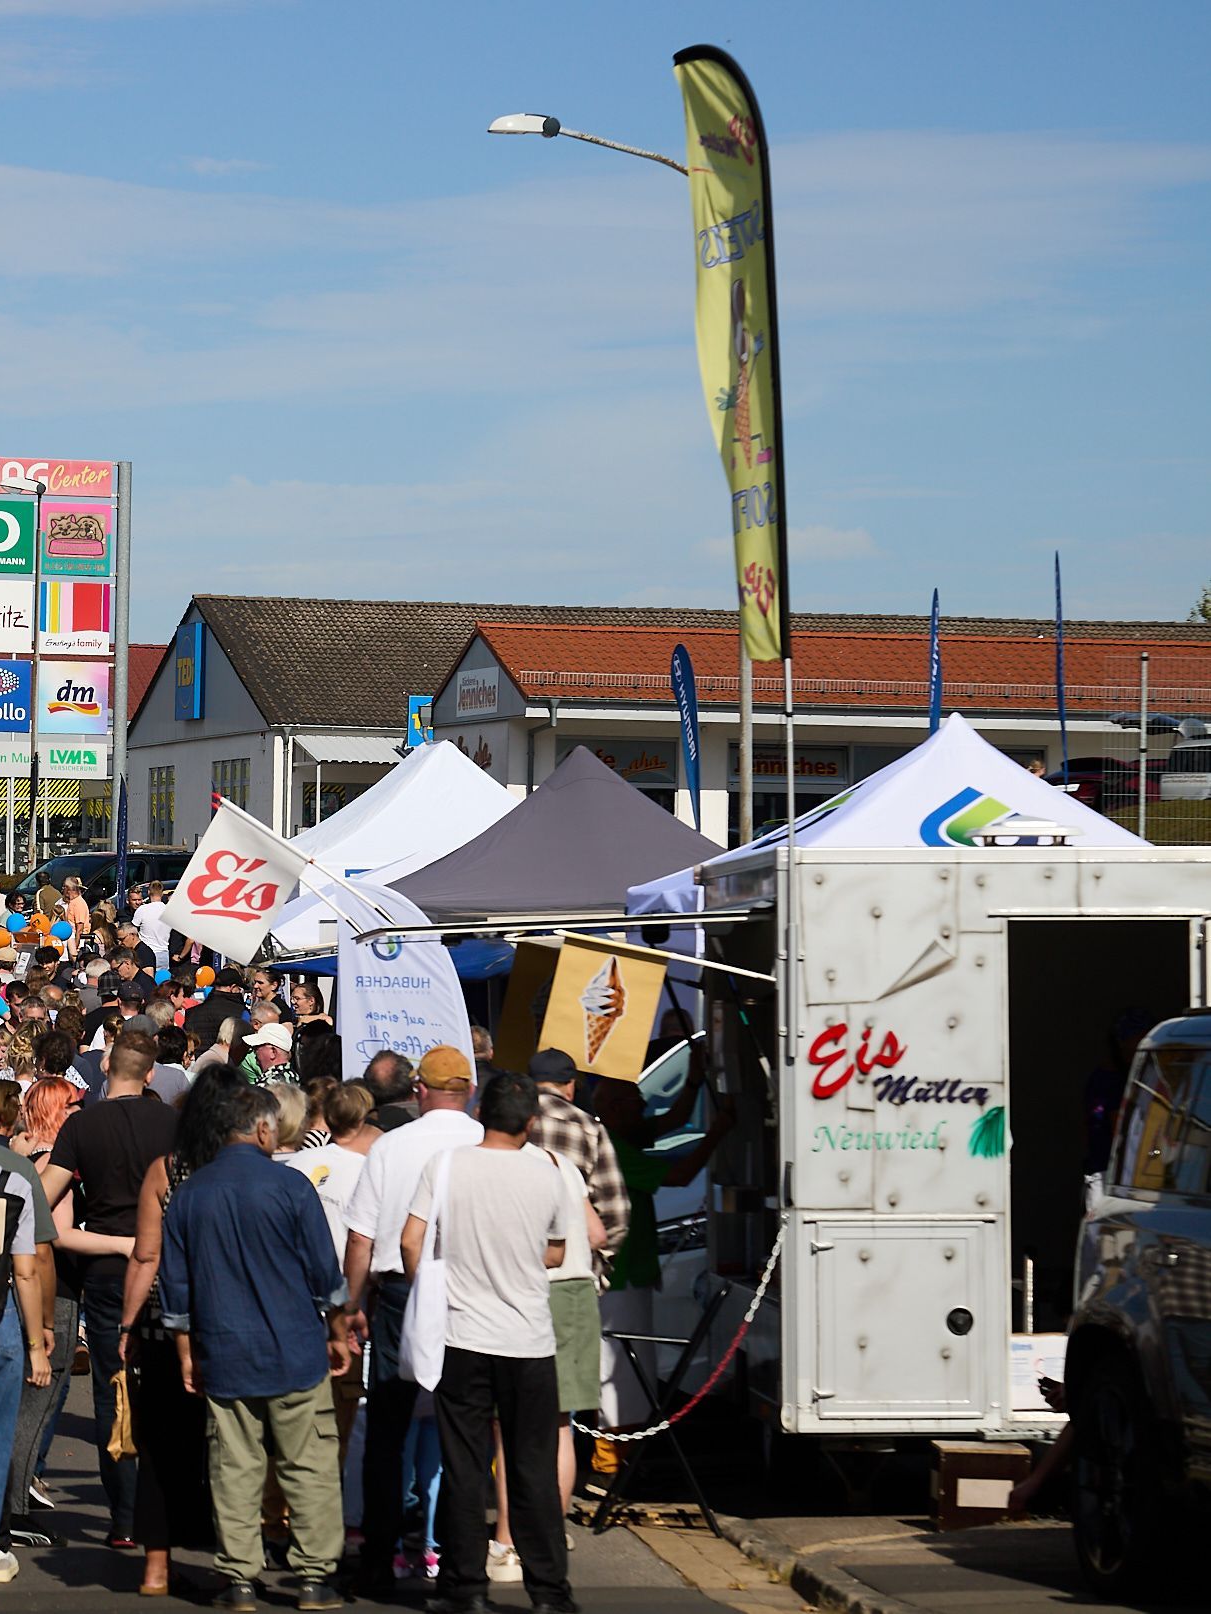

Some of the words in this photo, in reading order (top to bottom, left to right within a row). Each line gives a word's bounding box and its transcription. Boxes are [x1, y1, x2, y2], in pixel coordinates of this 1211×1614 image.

[49, 464, 109, 492] Center
[77, 638, 102, 649] family
[56, 680, 95, 702] dm
[679, 683, 697, 761] HYUNDAI
[50, 750, 82, 764] LVM
[187, 850, 280, 912] Eis
[808, 1023, 908, 1100] Eis
[872, 1074, 990, 1105] Müller
[811, 1120, 948, 1153] Neuwied
